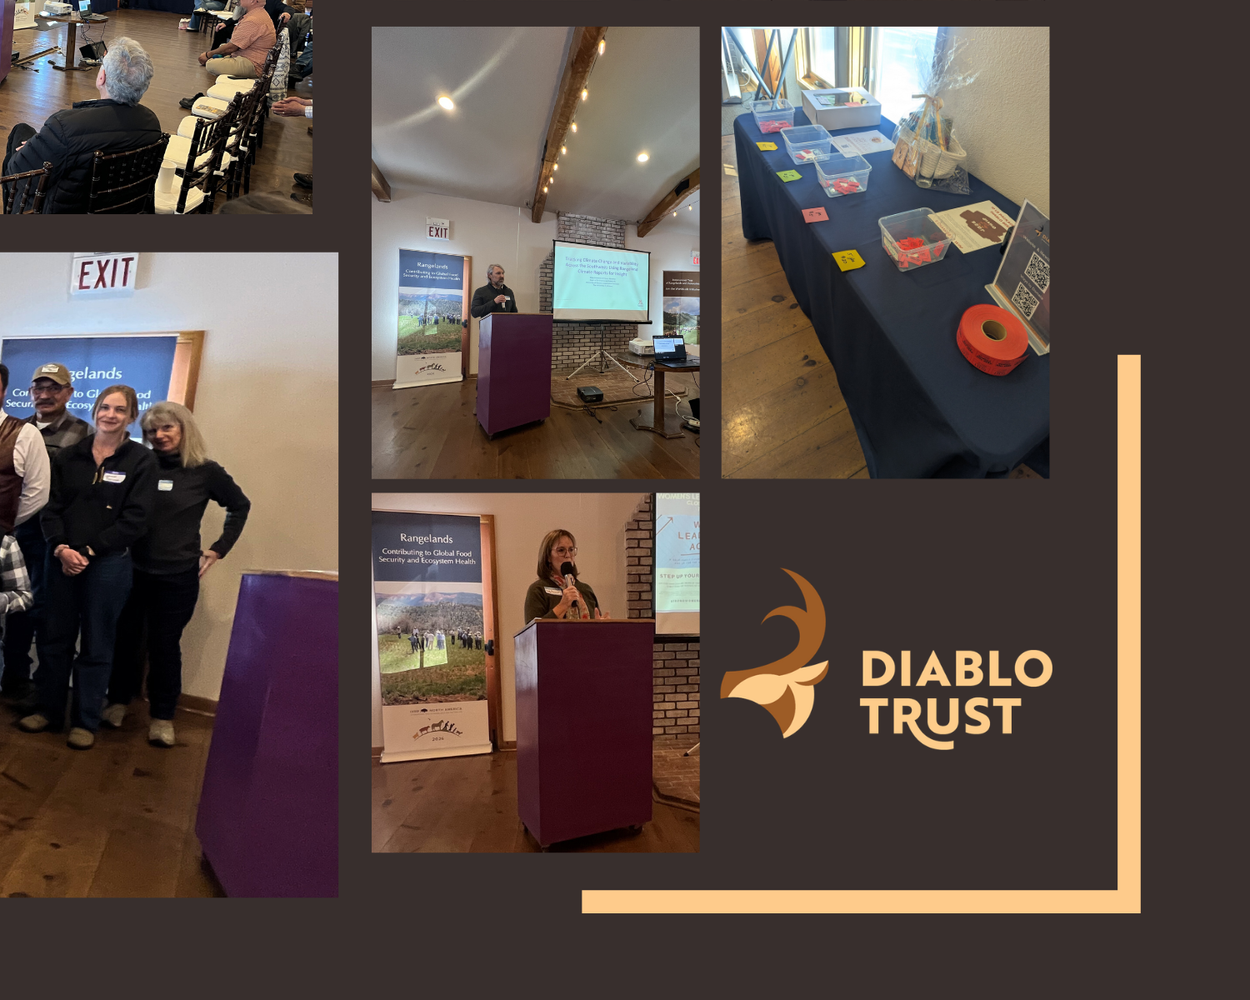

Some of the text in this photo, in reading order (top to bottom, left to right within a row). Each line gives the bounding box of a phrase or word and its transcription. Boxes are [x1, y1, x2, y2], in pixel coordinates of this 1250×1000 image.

[429, 226, 448, 239] EXIT
[79, 257, 134, 290] EXIT
[73, 390, 84, 398] to
[400, 533, 454, 545] Rangelands
[381, 547, 424, 557] Contributing
[433, 549, 454, 557] Global
[378, 556, 405, 564] Security
[421, 557, 453, 565] Ecosystem
